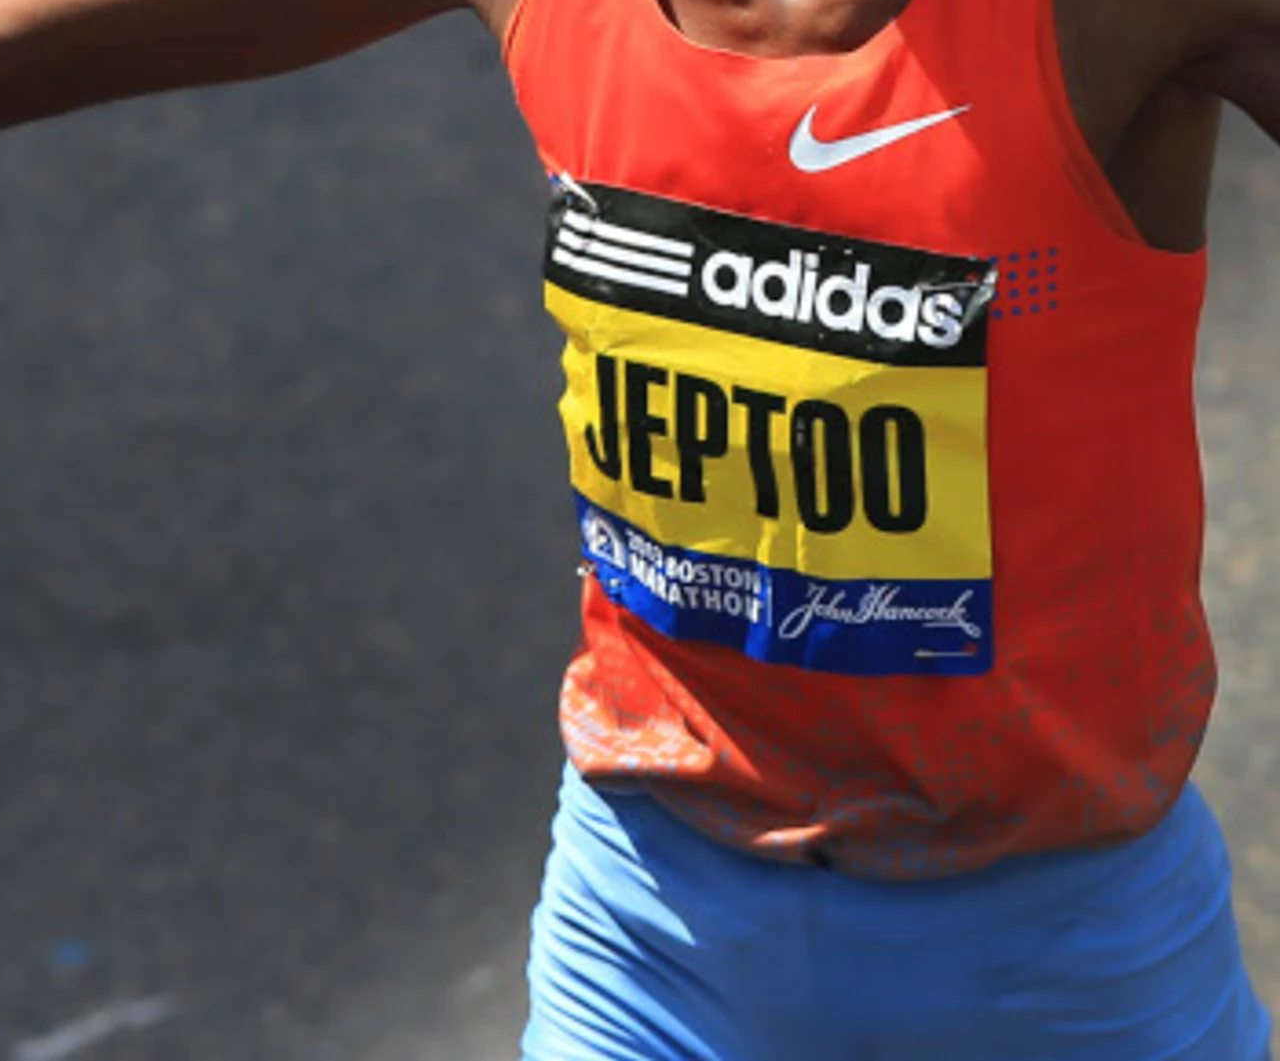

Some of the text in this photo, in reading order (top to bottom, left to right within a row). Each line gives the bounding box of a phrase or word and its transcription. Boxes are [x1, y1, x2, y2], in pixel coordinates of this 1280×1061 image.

[701, 249, 963, 349] adidas
[585, 354, 928, 535] JEPTOO
[628, 552, 764, 624] MARATHON
[664, 555, 762, 595] BOSTON
[778, 582, 982, 639] John Hancock
